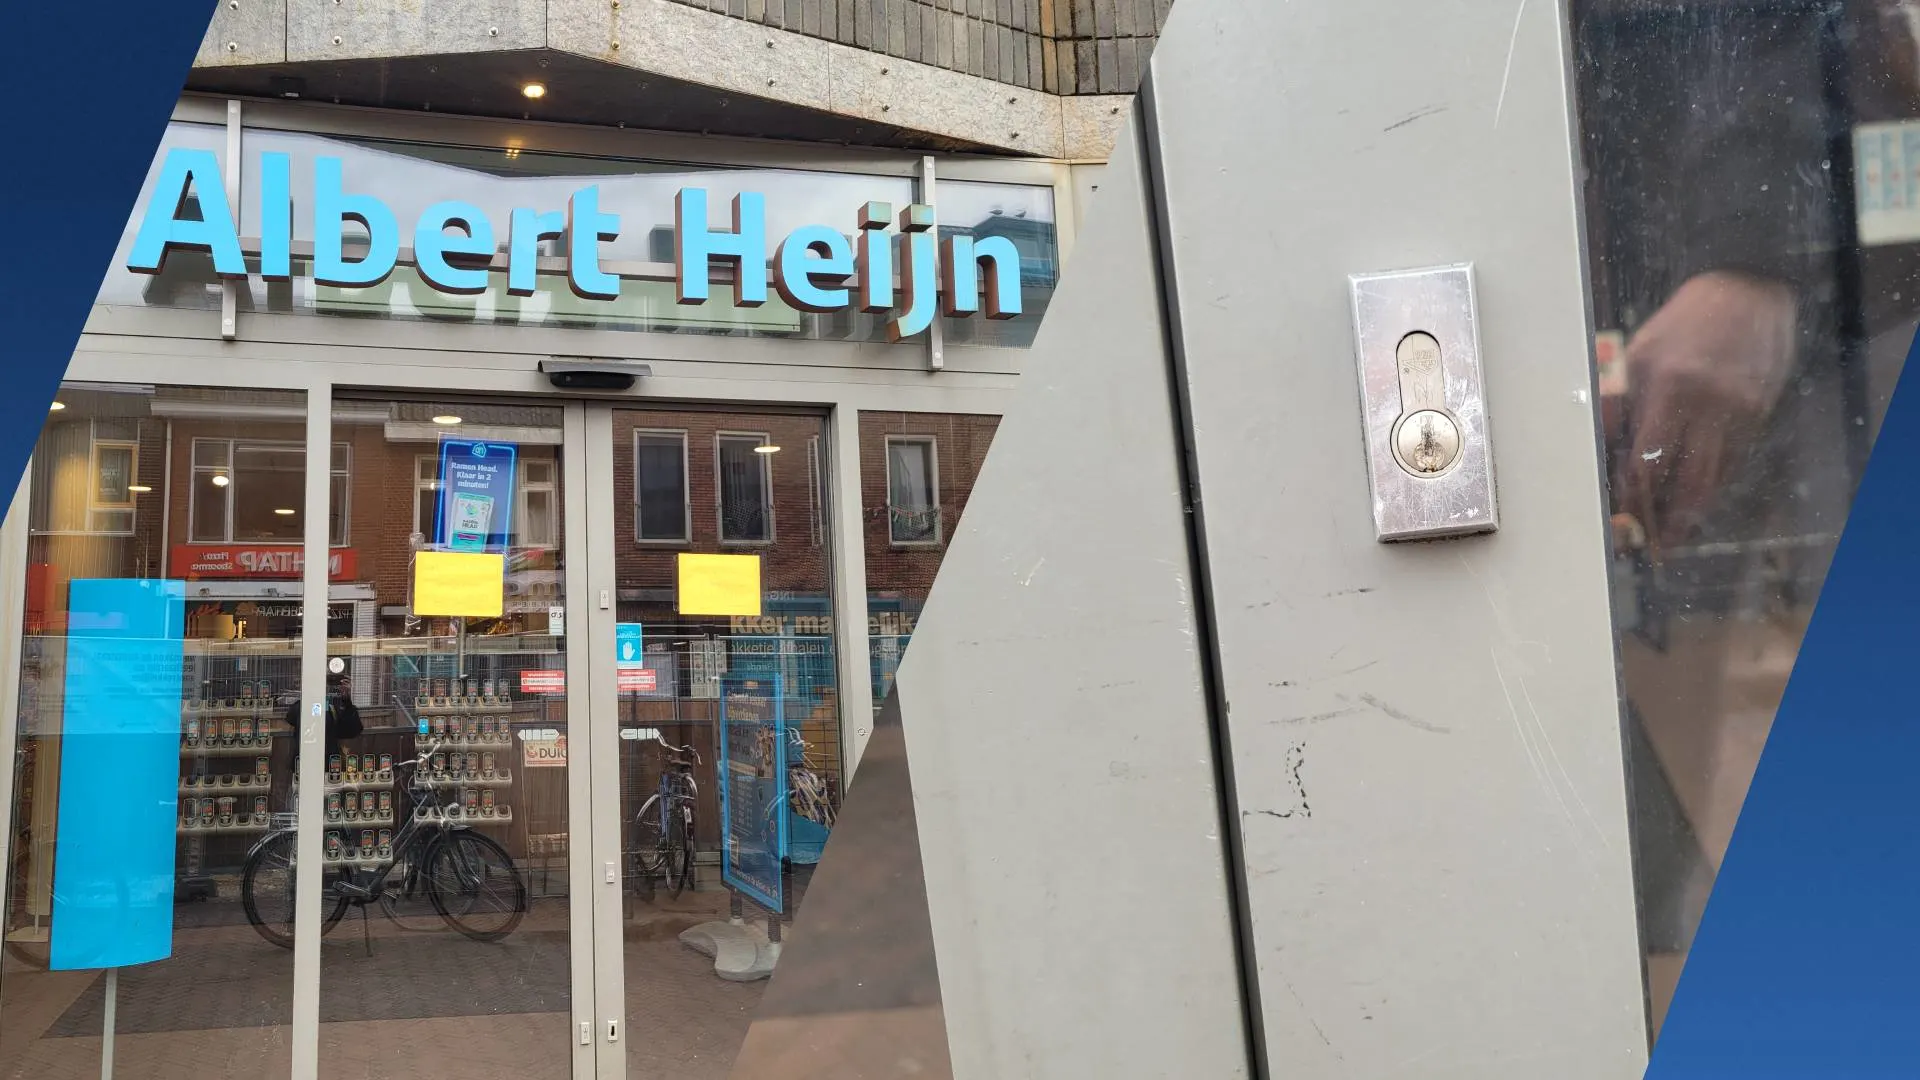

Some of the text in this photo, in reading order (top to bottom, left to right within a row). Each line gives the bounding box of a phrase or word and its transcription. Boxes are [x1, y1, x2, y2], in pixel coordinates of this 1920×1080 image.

[126, 147, 1022, 343] Albert Heijn
[451, 462, 476, 470] Ramen
[456, 471, 492, 481] Klaar in 2
[457, 480, 489, 489] minuten!
[730, 615, 788, 634] kker
